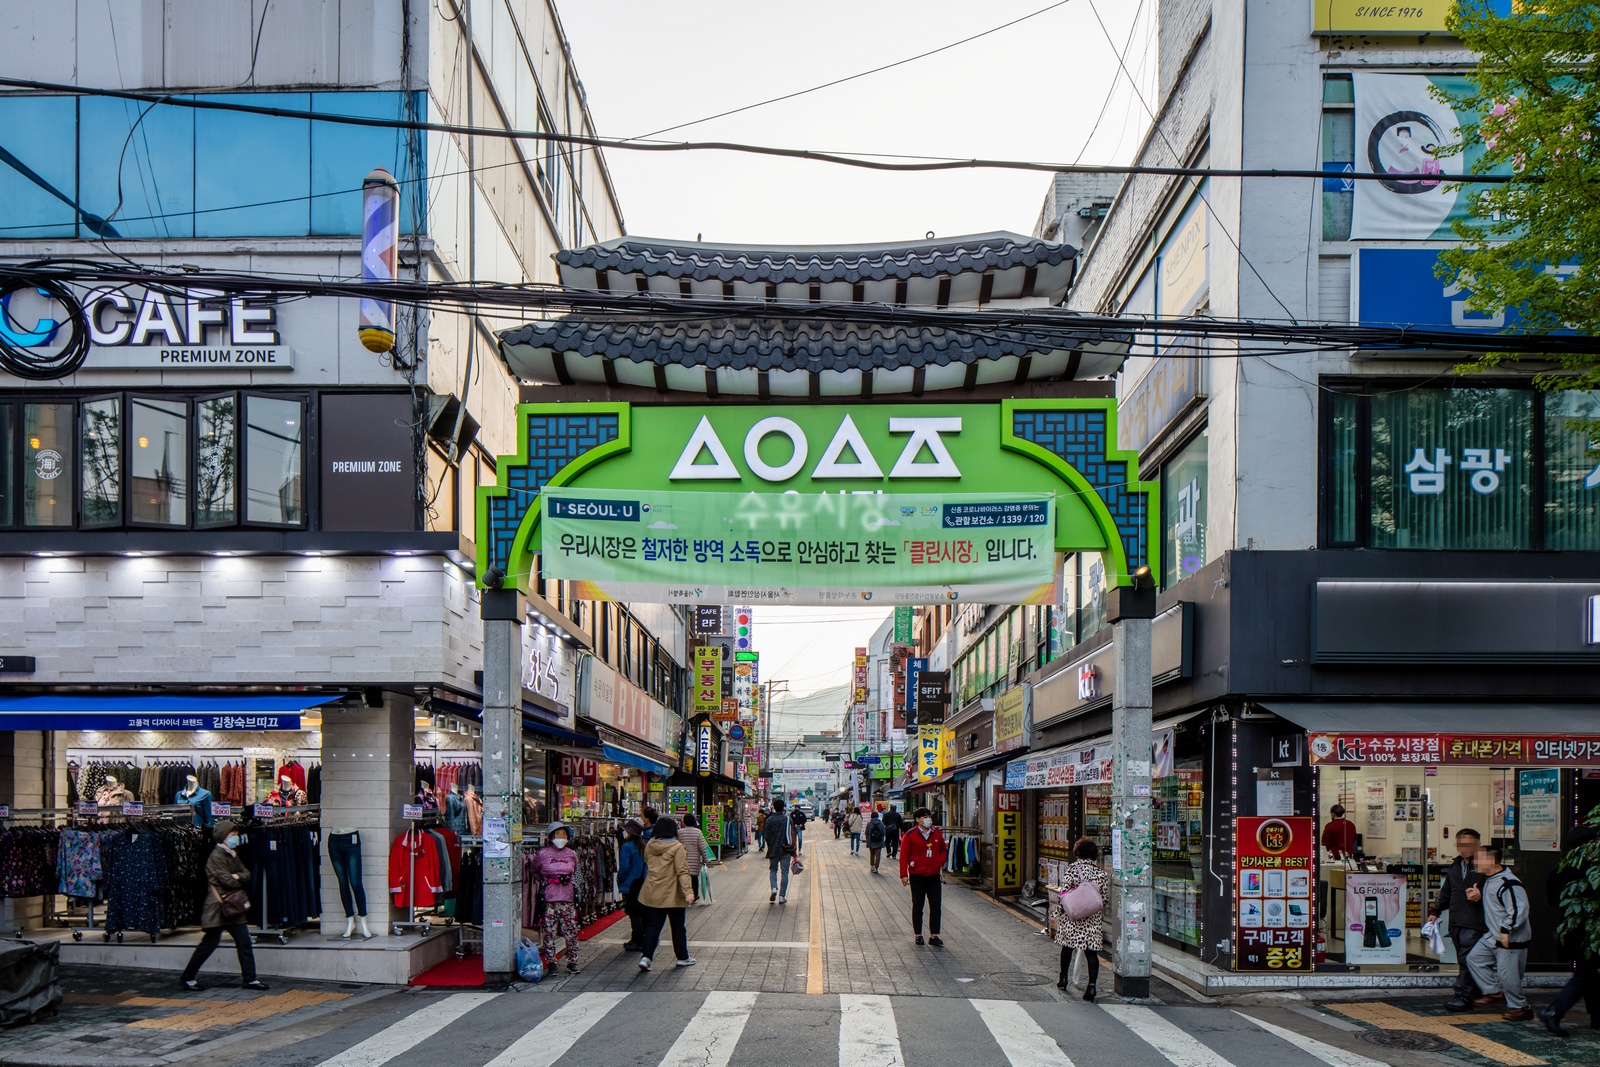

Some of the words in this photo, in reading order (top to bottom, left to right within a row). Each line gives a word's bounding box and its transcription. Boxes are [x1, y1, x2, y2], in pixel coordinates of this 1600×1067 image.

[1355, 6, 1396, 17] SINCE
[1398, 7, 1423, 18] 1976
[1165, 216, 1202, 283] SHENPIX
[160, 350, 231, 363] PREMIUM
[235, 350, 276, 363] ZONE
[332, 461, 376, 473] PREMIUM
[378, 461, 402, 472] ZONE
[1404, 447, 1512, 495] 삼광
[963, 505, 1003, 513] 코로나바이러스
[1001, 514, 1022, 524] 1339
[1029, 513, 1045, 523] 120
[560, 534, 637, 560] 우리시장은
[641, 537, 689, 562] 철저한
[693, 539, 724, 563] 방역
[729, 540, 793, 564] 소독으로
[797, 541, 861, 565] 안심하고
[864, 540, 897, 565] 찾는
[985, 537, 1037, 562] 입니다.
[702, 619, 716, 627] 2F
[698, 648, 719, 656] 삼성
[700, 659, 715, 702] 부동산
[618, 681, 649, 735] BYC
[128, 718, 150, 726] 고품격
[152, 718, 180, 727] 디자이너
[182, 719, 204, 727] 브랜드
[701, 727, 709, 769] 스포츠
[1279, 740, 1290, 757] kt
[1316, 743, 1327, 752] 1등
[1338, 738, 1366, 761] kt
[1369, 738, 1439, 751] 수유시장점
[1450, 739, 1521, 759] 휴대폰가격
[922, 737, 938, 779] 미용실
[1369, 753, 1396, 762] 100%
[1401, 753, 1440, 762] 보장제도
[561, 757, 594, 776] BYC
[672, 793, 693, 803] 삼성
[998, 793, 1020, 810] 대박
[706, 813, 721, 843] 부동산
[1266, 834, 1283, 847] kt
[1002, 813, 1016, 886] 부동산
[1285, 857, 1309, 867] BEST
[1243, 930, 1305, 946] 구매고객
[1248, 955, 1259, 963] 택1
[1266, 947, 1303, 969] 증정
